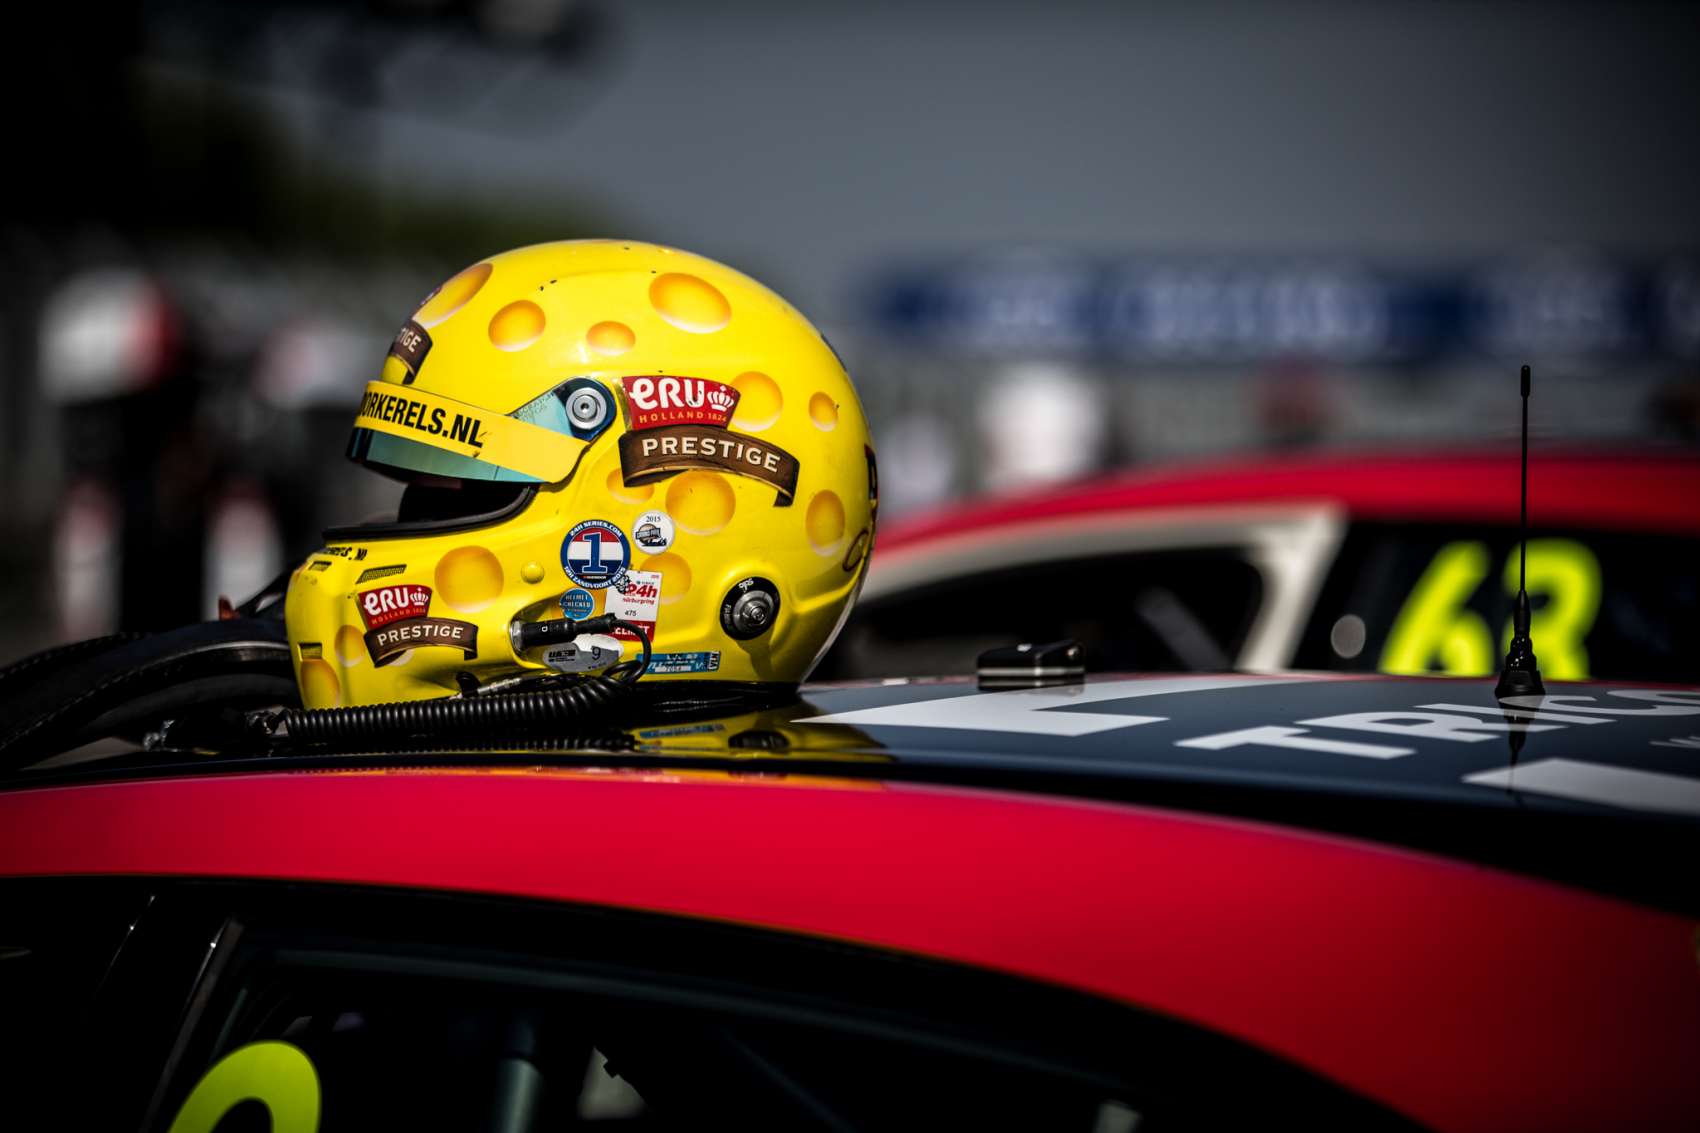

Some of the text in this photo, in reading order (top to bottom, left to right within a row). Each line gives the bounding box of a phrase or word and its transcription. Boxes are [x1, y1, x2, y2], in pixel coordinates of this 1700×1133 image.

[639, 411, 728, 424] HOLLAND 1824
[641, 436, 781, 473] PRESTIGE
[646, 515, 662, 523] 2015
[582, 531, 608, 574] 1
[624, 583, 658, 598] 24h
[376, 624, 464, 647] PRESTIGE
